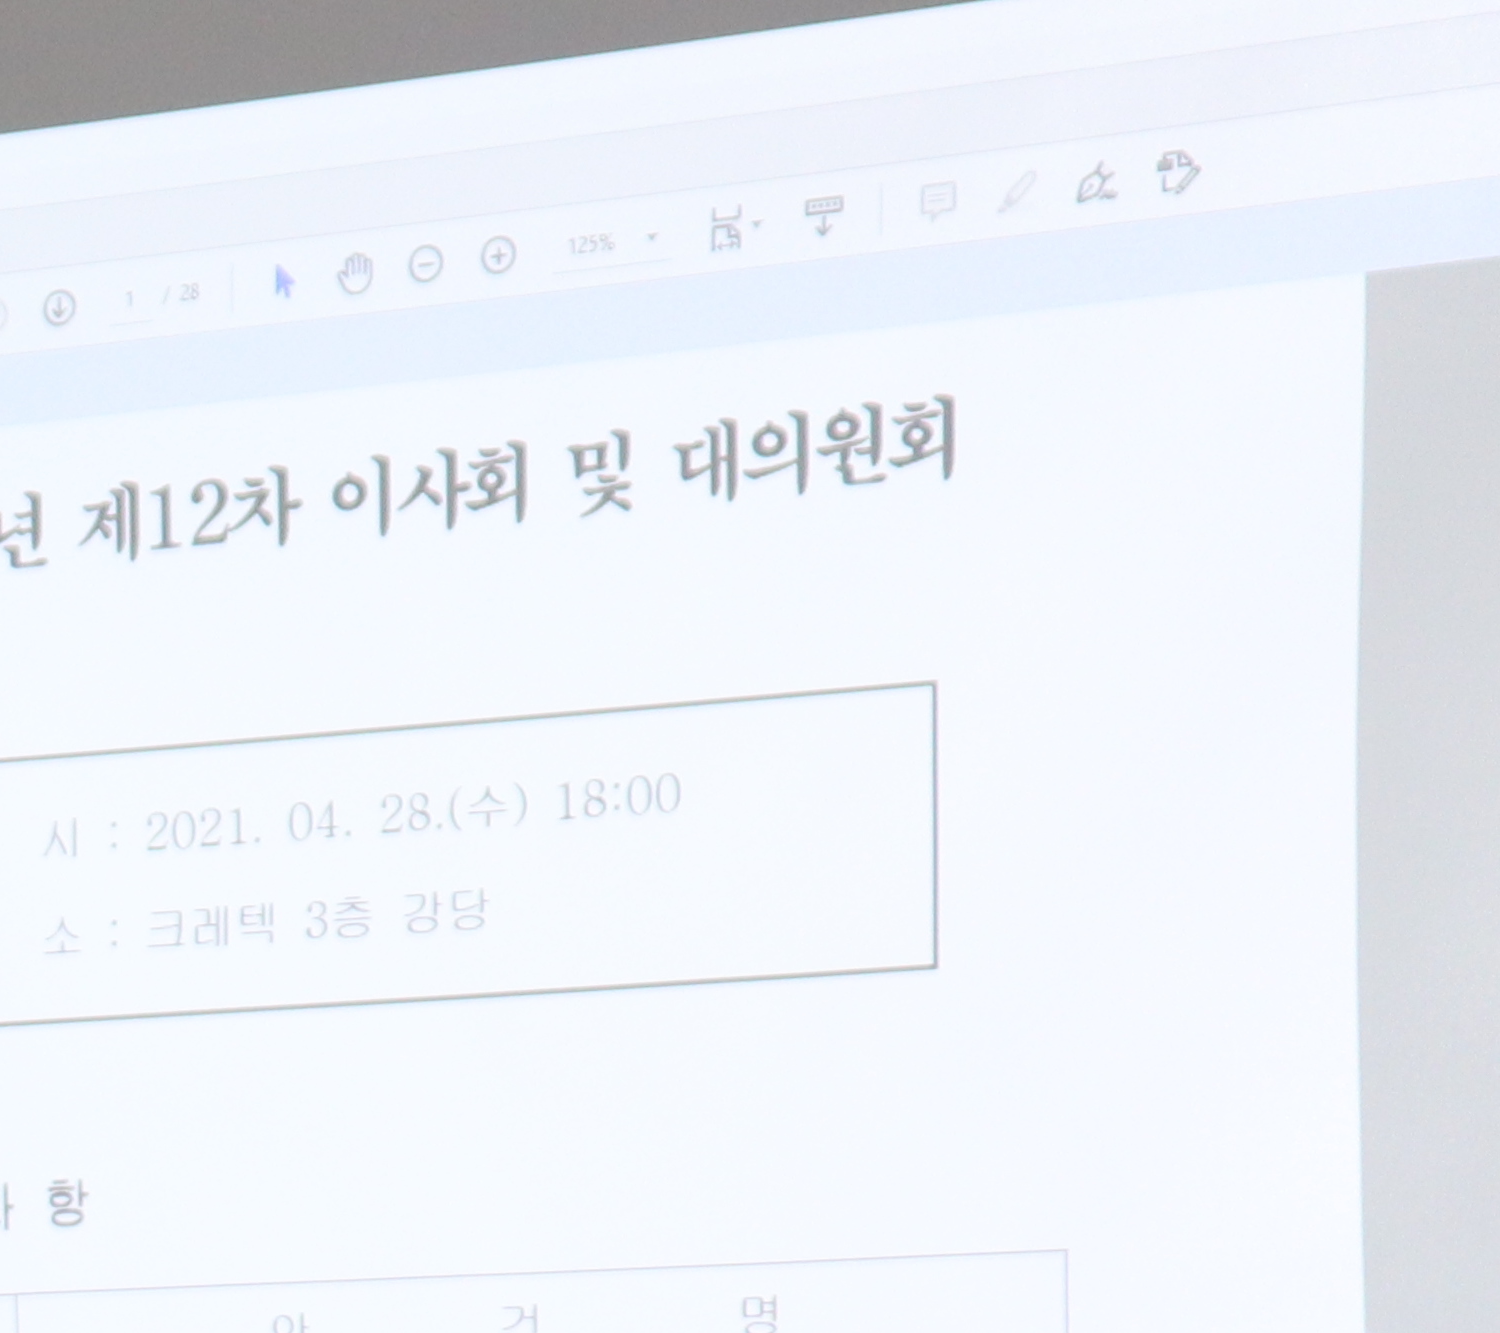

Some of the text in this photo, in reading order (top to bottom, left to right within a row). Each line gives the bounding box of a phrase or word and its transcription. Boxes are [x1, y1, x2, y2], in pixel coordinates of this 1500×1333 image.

[567, 231, 617, 257] 125%
[178, 281, 201, 303] 28
[77, 464, 304, 565] 제12차
[329, 437, 531, 538] 이사회
[566, 428, 634, 519] 및
[671, 392, 958, 503] 대의원회
[144, 804, 263, 852] 2021.
[287, 799, 354, 845] 04.
[555, 770, 683, 822] 18:00
[145, 900, 277, 953] 크레텍
[304, 894, 374, 943] 3층
[400, 885, 492, 938] 강당
